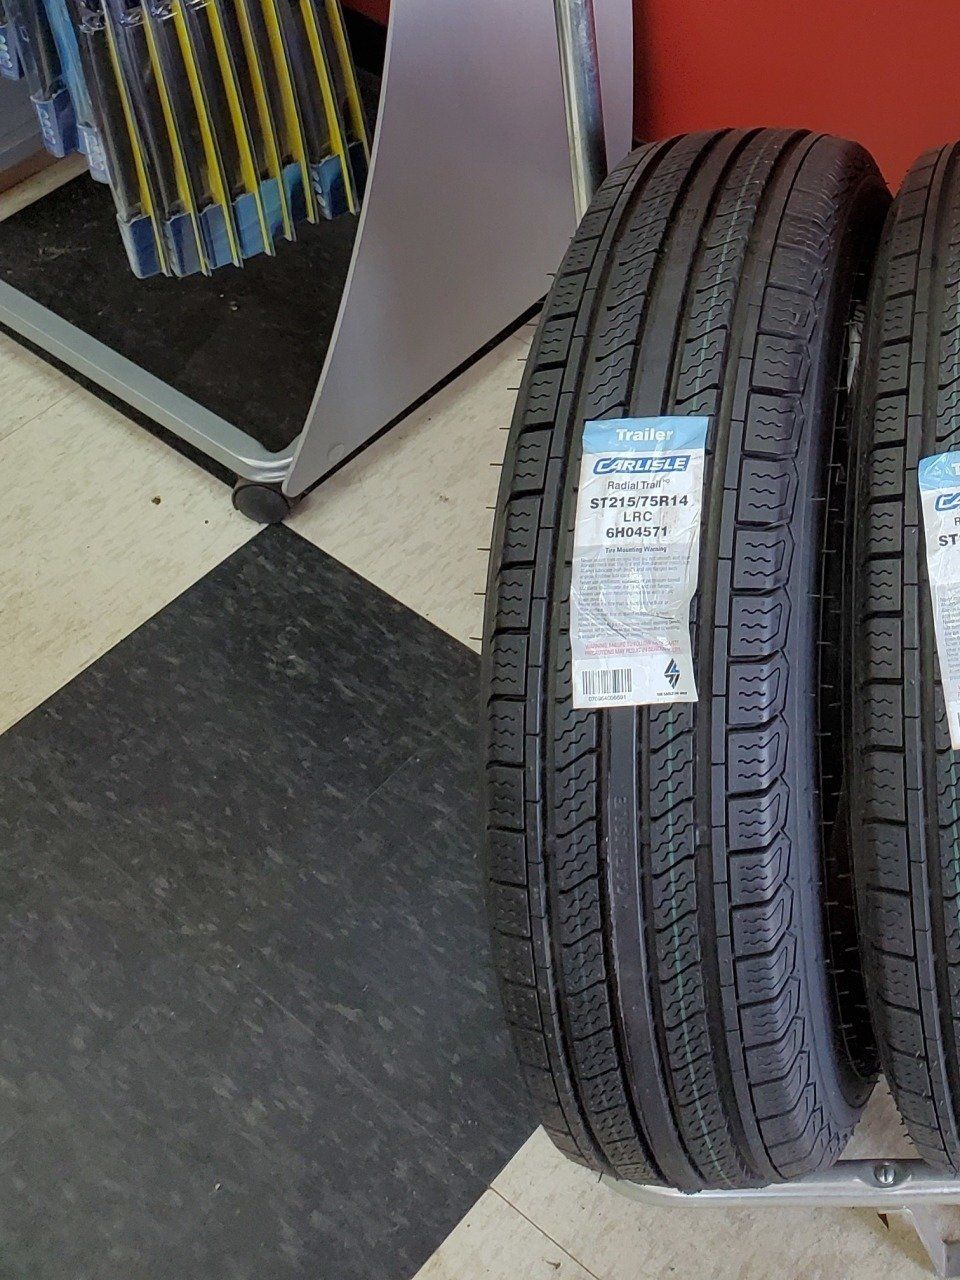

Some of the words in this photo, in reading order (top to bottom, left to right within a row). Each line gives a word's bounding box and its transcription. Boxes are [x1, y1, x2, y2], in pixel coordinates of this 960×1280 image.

[616, 428, 674, 441] Trailer
[595, 456, 689, 473] CARLISLE
[608, 480, 638, 490] Radial
[590, 495, 688, 509] ST215/75R14
[624, 511, 652, 522] LRC
[606, 526, 667, 538] 6H04571
[617, 546, 642, 554] Mounting
[644, 546, 667, 554] Warning
